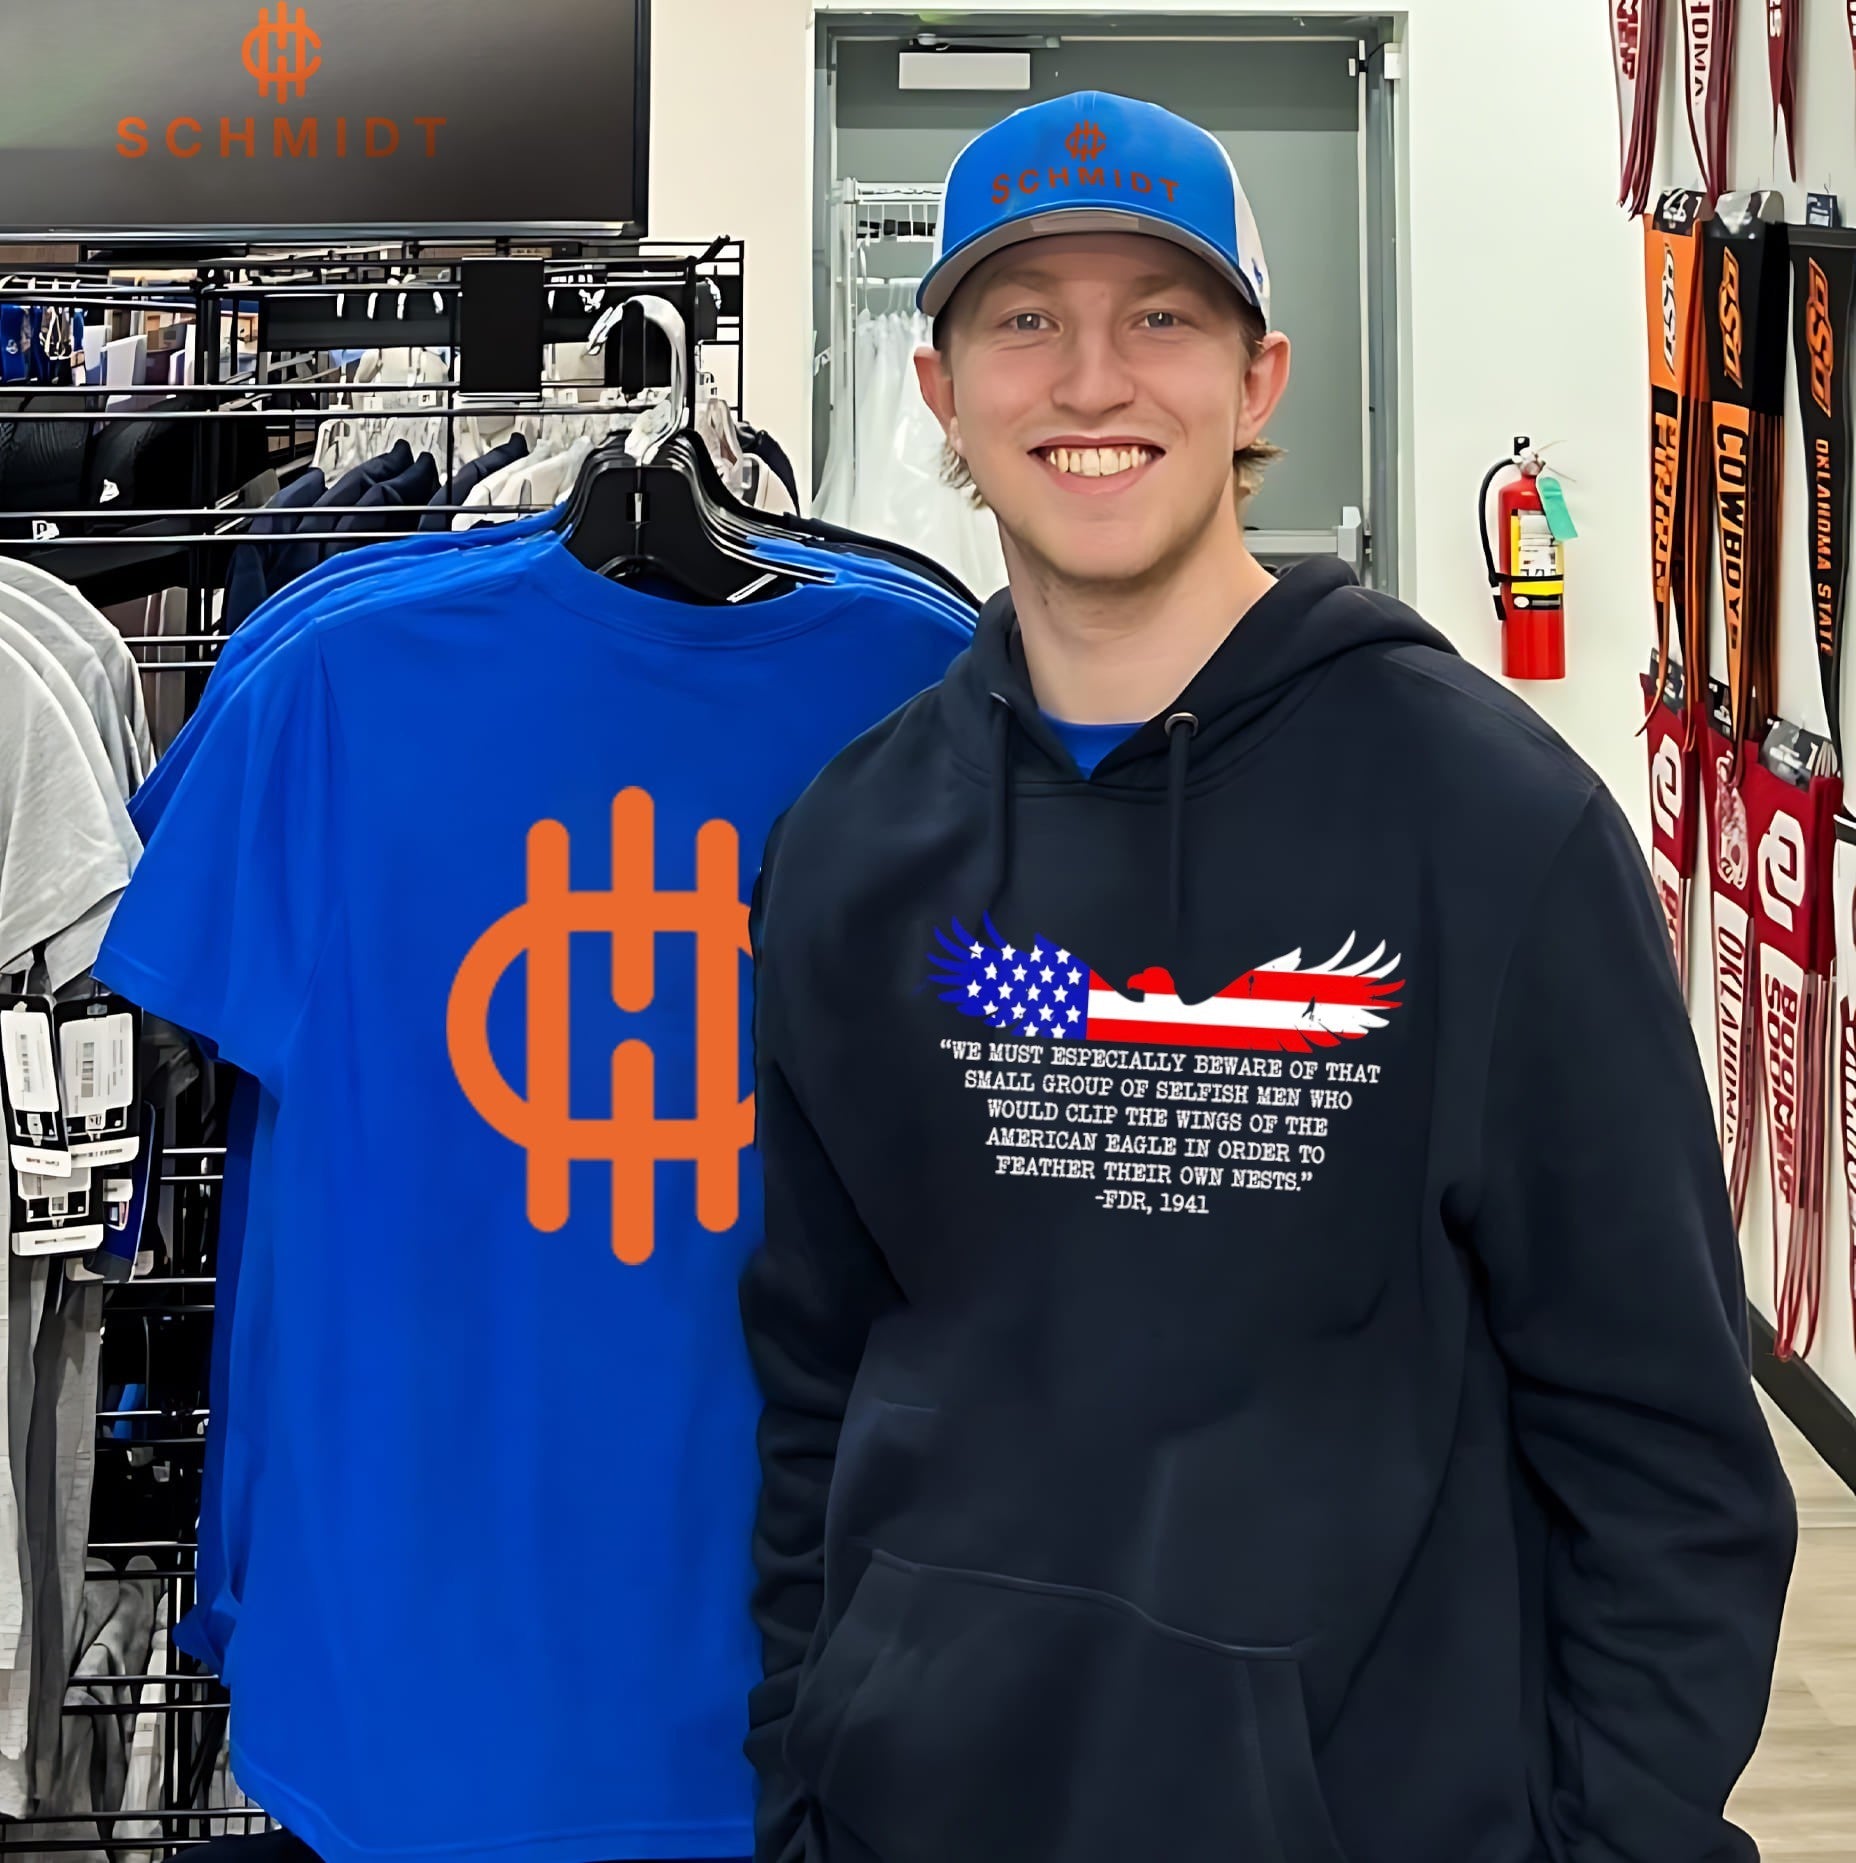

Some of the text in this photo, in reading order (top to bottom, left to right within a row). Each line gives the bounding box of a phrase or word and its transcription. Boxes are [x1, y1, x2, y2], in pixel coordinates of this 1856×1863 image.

[116, 116, 447, 158] SCHMIDT
[991, 166, 1181, 205] SCHMIDT
[1815, 438, 1833, 570] OKLAHOMA
[1717, 925, 1746, 1143] OKLAHOMA
[939, 1038, 1381, 1084] “WE MUST ESPECIALLY BEWARE OF THAT
[964, 1069, 1353, 1111] SMALL GROUP OF SELFISH MEN WHO
[986, 1098, 1329, 1137] WOULD CLIP THE WINGS OF THE
[985, 1126, 1326, 1165] AMERICAN EAGLE IN ORDER TO
[994, 1154, 1314, 1192] FEATHER THEIR OWN NESTS.”
[1094, 1188, 1210, 1215] -FDR, 1941
